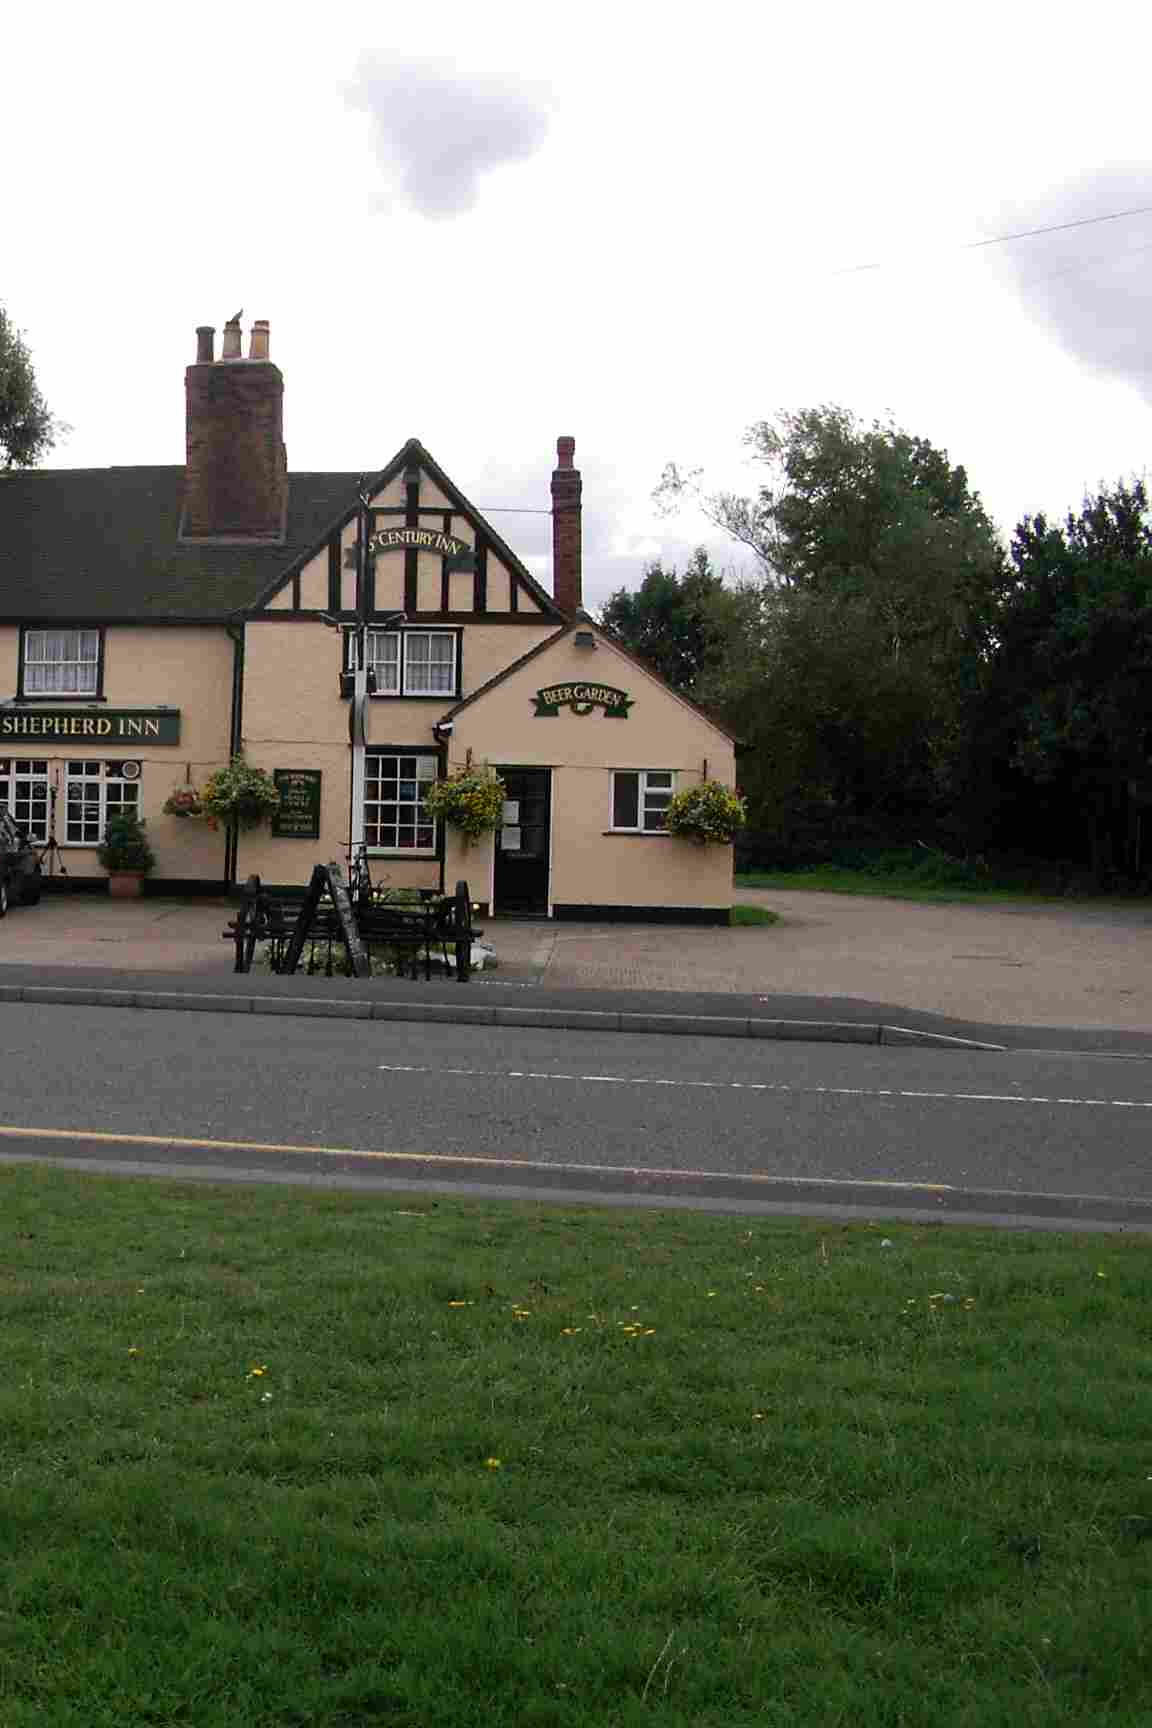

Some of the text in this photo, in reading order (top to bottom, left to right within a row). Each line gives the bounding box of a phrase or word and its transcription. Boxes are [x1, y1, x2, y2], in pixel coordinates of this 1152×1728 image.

[378, 530, 433, 546] CENTURY
[434, 534, 464, 555] INN
[543, 685, 624, 706] BEER GARDEN
[1, 716, 112, 736] SHEPHERD
[118, 717, 160, 736] INN
